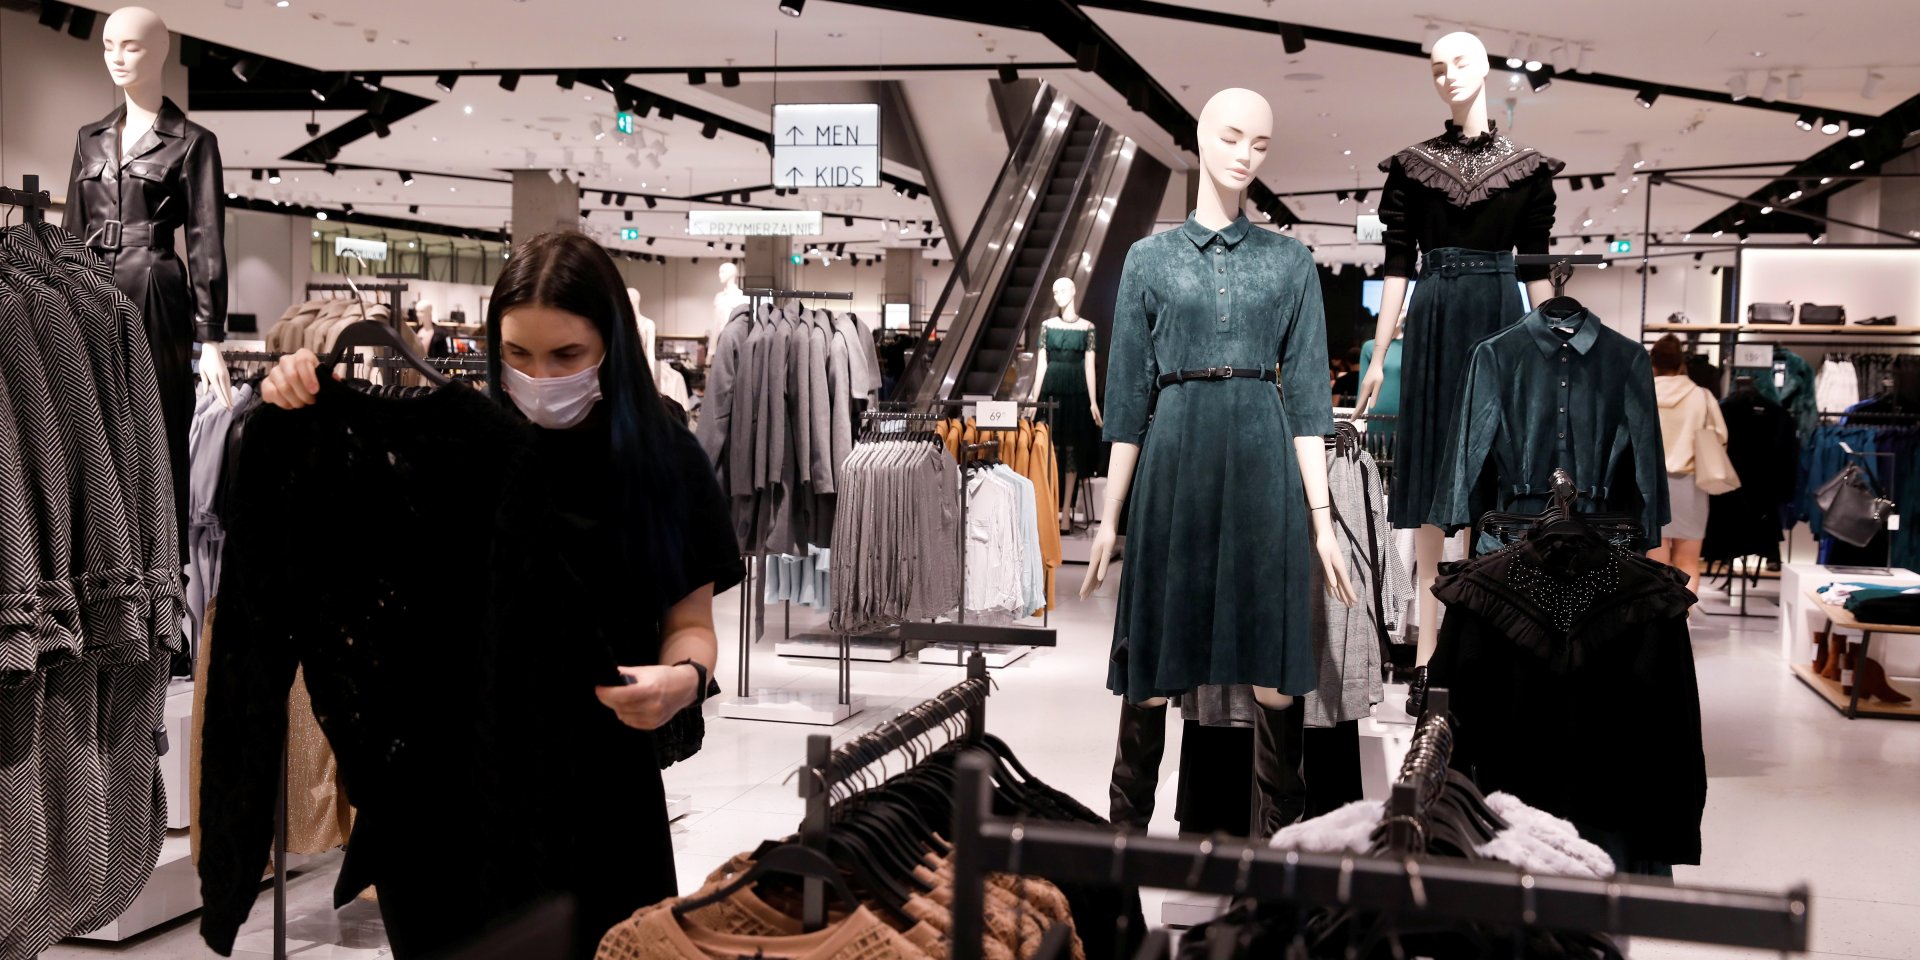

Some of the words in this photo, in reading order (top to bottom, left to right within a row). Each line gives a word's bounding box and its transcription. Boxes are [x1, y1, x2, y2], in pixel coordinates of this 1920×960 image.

[816, 125, 859, 146] MEN
[816, 166, 864, 187] KIDS
[709, 222, 815, 235] PRZYMIERZALNIE
